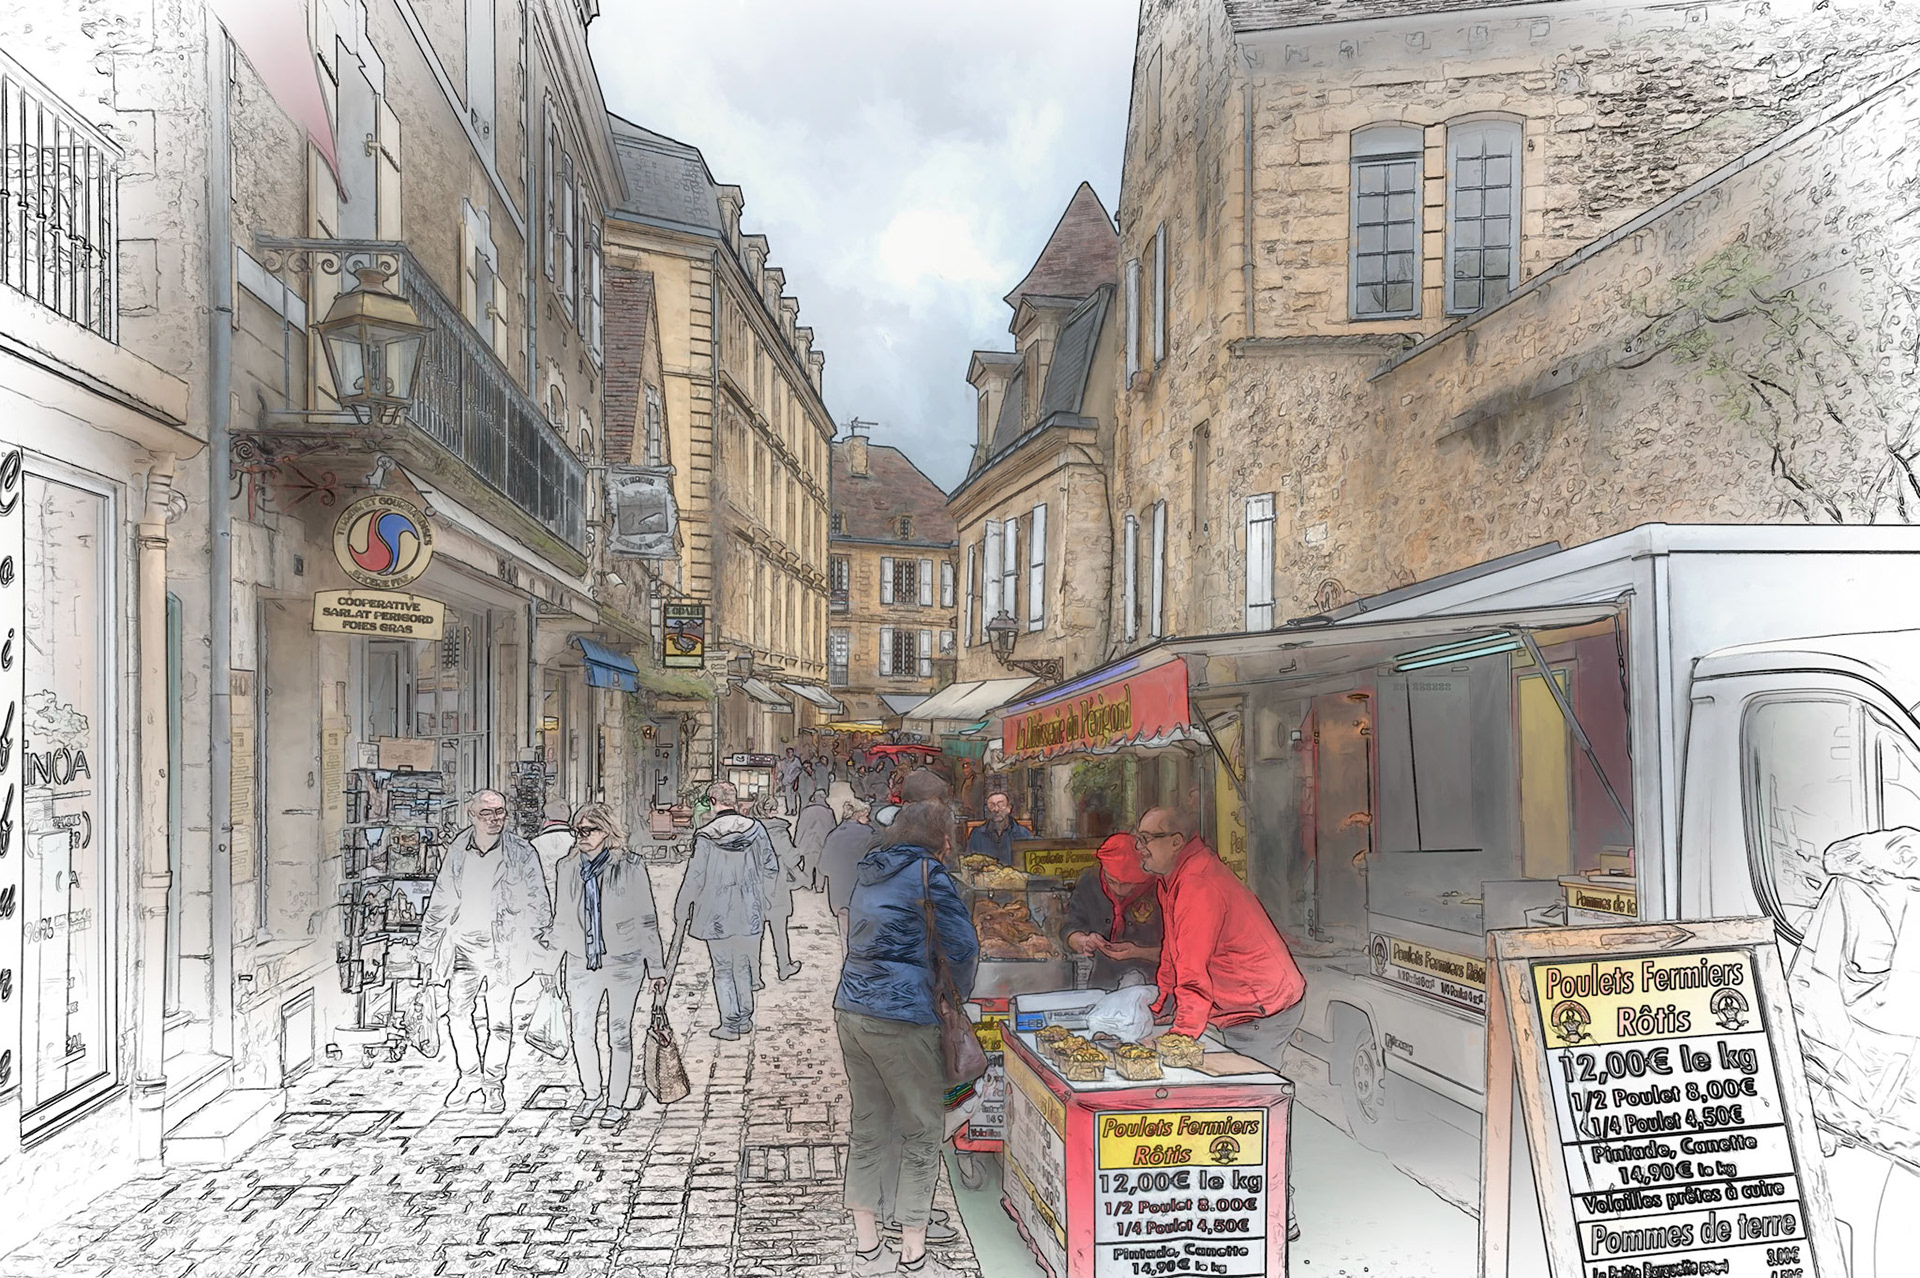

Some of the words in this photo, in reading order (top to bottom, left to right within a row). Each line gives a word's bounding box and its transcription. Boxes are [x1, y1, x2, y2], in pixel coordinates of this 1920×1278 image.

[322, 607, 372, 619] SARLAT
[374, 611, 434, 624] PERIGORD
[337, 597, 421, 611] COOPERATIVE
[342, 620, 377, 631] FOIES
[379, 623, 413, 634] GRAS
[1066, 704, 1079, 742] du
[1080, 683, 1132, 749] Périgord
[1576, 890, 1611, 910] Pommes
[1613, 895, 1625, 912] de
[1393, 943, 1424, 967] Poulets
[1424, 950, 1464, 978] Fermiers
[1546, 963, 1634, 1000] Poulets
[1641, 958, 1744, 992] Fermiers
[1617, 1004, 1691, 1037] Rôtis
[1558, 1047, 1673, 1085] 12,00€
[1680, 1044, 1711, 1073] le
[1717, 1041, 1759, 1074] kg
[1572, 1089, 1607, 1113] 1/2
[1612, 1084, 1681, 1108] Poulet
[1685, 1077, 1758, 1104] 8,00€
[1102, 1116, 1173, 1138] Poulets
[1177, 1115, 1259, 1136] Fermiers
[1591, 1116, 1622, 1138] 1/4
[1624, 1111, 1681, 1134] Poulet
[1686, 1105, 1746, 1130] 4,50€
[1133, 1145, 1192, 1165] Rôtis
[1591, 1141, 1677, 1164] Pintade,
[1680, 1134, 1758, 1155] Canette
[1099, 1170, 1190, 1195] 12,00€
[1200, 1170, 1224, 1190] le
[1232, 1170, 1263, 1193] kg
[1618, 1161, 1694, 1185] 14,90€
[1698, 1162, 1714, 1177] le
[1715, 1161, 1737, 1177] kg
[1105, 1200, 1132, 1216] 1/2
[1138, 1198, 1193, 1214] Poulet
[1582, 1193, 1663, 1215] Volailles
[1667, 1185, 1722, 1210] prêtes
[1725, 1182, 1737, 1200] à
[1741, 1180, 1785, 1198] cuire
[1117, 1221, 1141, 1236] 1/4
[1147, 1218, 1193, 1234] Poulet
[1197, 1218, 1250, 1235] 4,50€
[1591, 1223, 1694, 1256] Pommes
[1700, 1211, 1732, 1244] de
[1737, 1212, 1797, 1240] terre
[1113, 1245, 1180, 1260] Pintade,
[1184, 1243, 1249, 1257] Canette
[1132, 1258, 1190, 1275] 14,90€
[1211, 1262, 1227, 1274] kg
